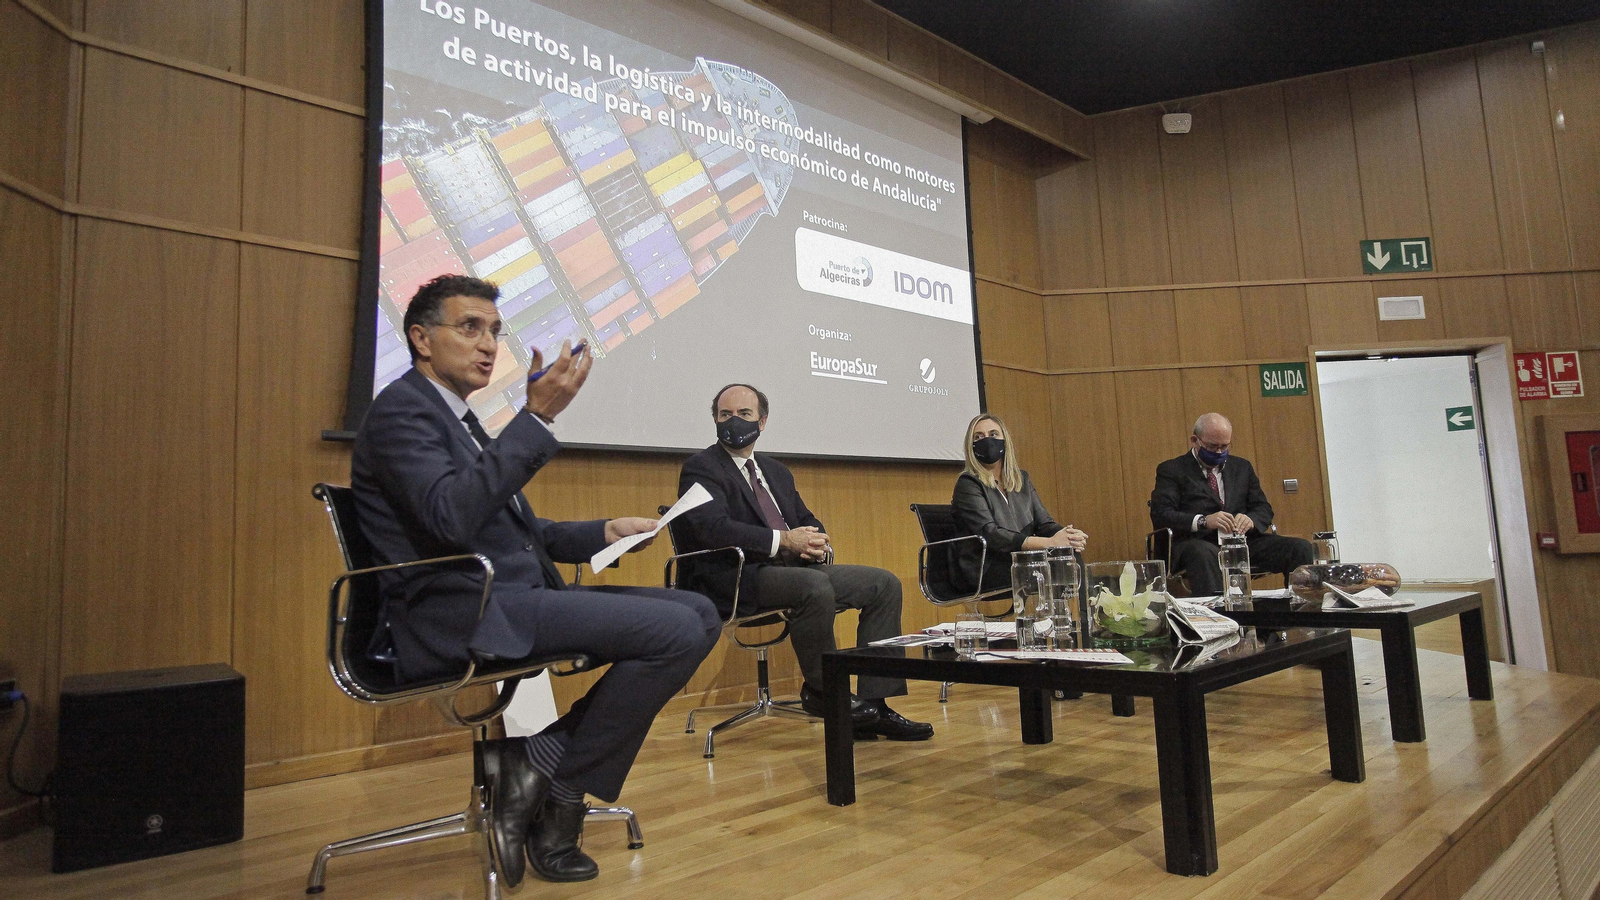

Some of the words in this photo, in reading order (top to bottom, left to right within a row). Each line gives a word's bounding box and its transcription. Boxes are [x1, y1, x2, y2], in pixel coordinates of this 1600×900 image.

[420, 0, 466, 25] Los
[474, 7, 576, 66] Puertos,
[582, 45, 602, 72] la
[609, 54, 696, 104] logística
[700, 90, 713, 112] y
[717, 93, 732, 117] la
[737, 102, 861, 161] intermodalidad
[864, 150, 902, 175] como
[904, 164, 956, 195] motores
[443, 36, 477, 66] de
[484, 53, 599, 104] actividad
[605, 92, 652, 121] para
[657, 108, 676, 129] el
[681, 112, 756, 153] impulso
[760, 141, 848, 184] económico
[851, 169, 869, 191] de
[872, 176, 942, 213] Andalucía"
[802, 210, 849, 233] Patrocina:
[819, 267, 861, 287] Algeciras
[828, 260, 851, 273] Puerto
[851, 266, 860, 275] de
[893, 270, 954, 305] IDOM
[808, 324, 852, 342] Organiza:
[810, 350, 878, 378] EuropaSur
[1263, 369, 1305, 391] SALIDA
